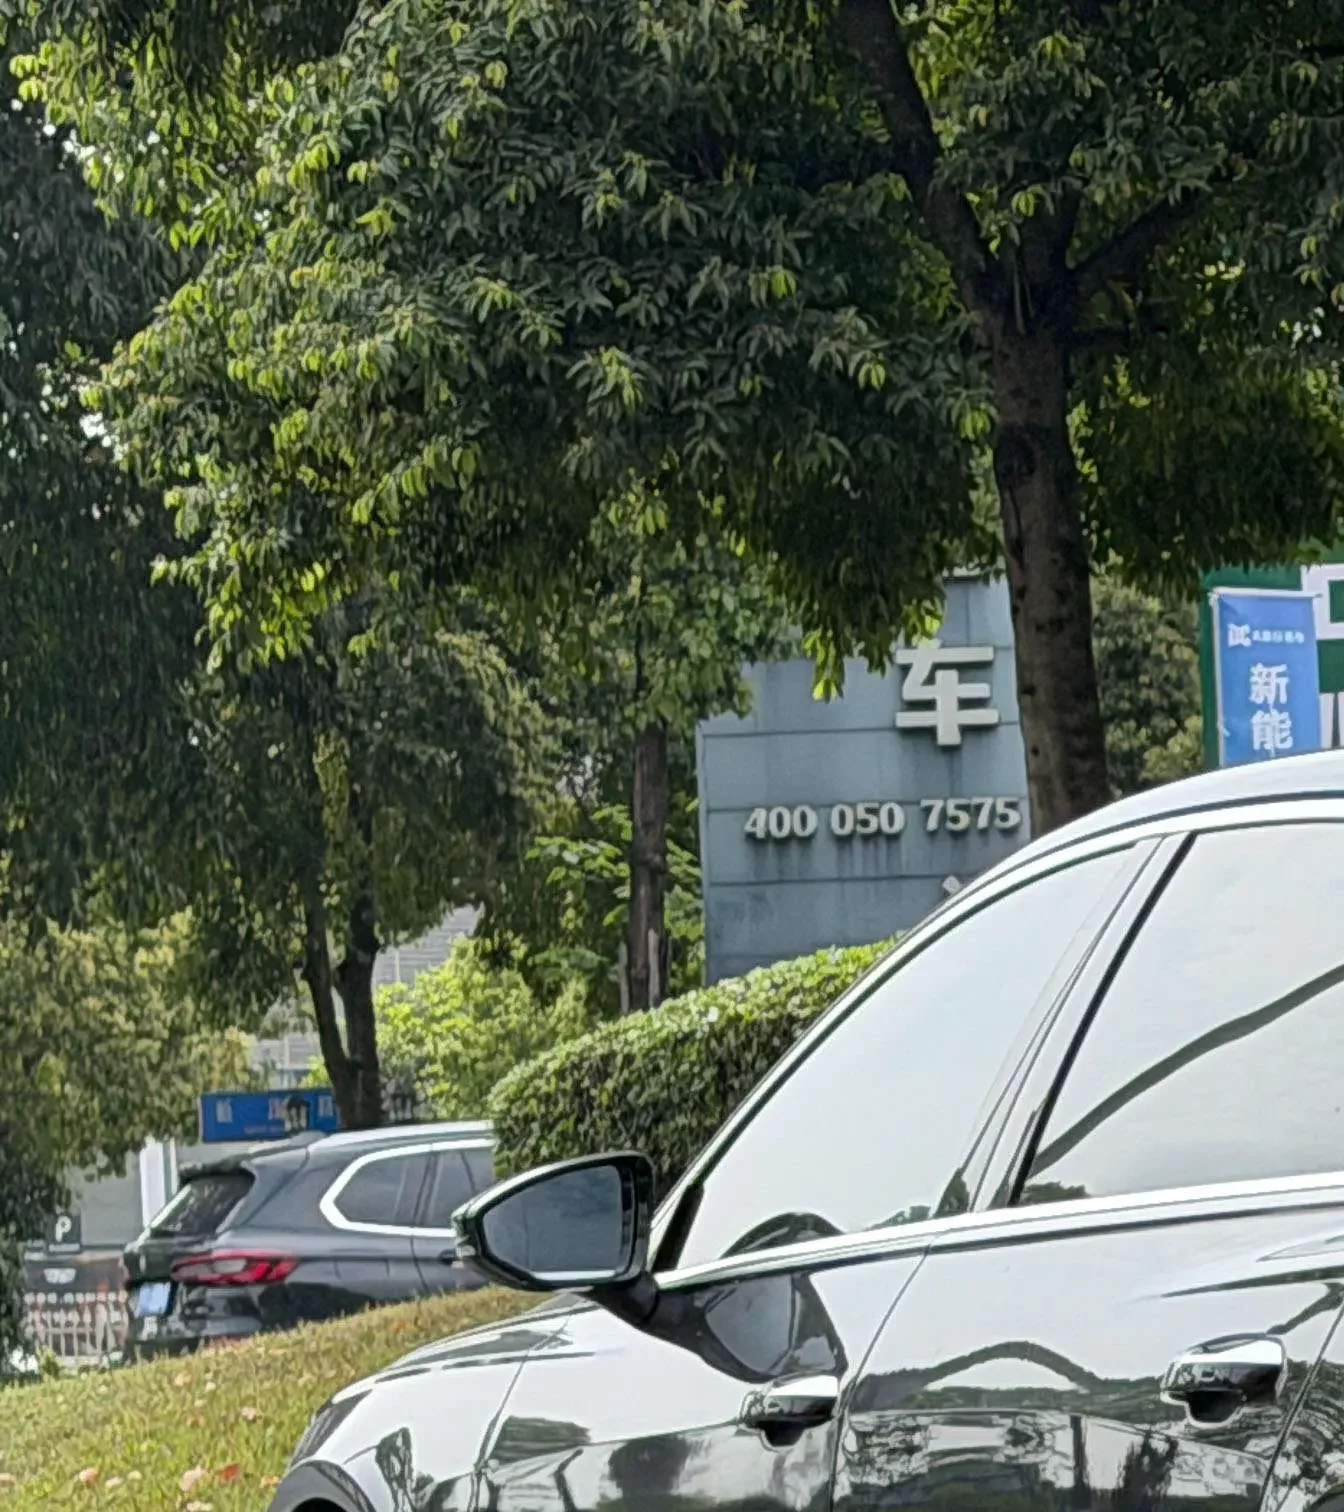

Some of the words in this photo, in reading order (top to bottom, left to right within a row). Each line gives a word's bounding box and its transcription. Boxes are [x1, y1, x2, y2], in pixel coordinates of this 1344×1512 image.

[895, 642, 1000, 746] 车
[743, 804, 818, 840] 400
[830, 801, 905, 837] 050
[920, 796, 1022, 833] 7575
